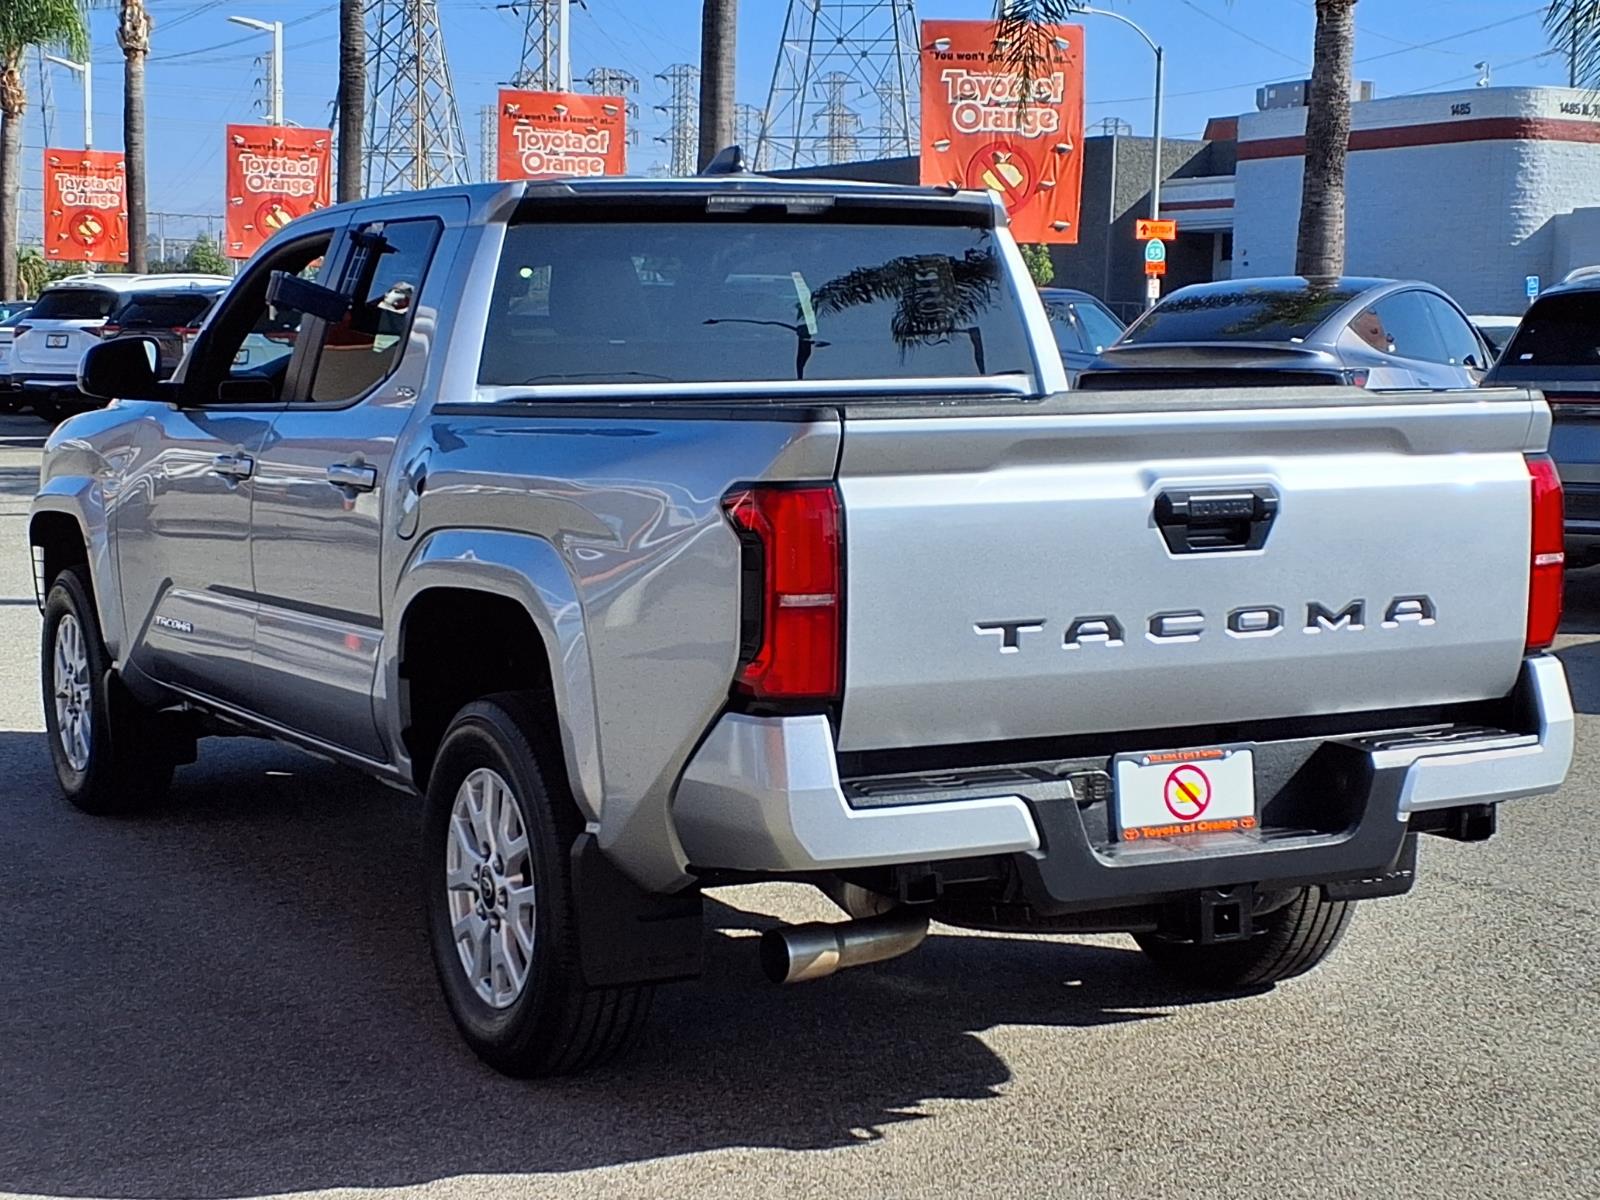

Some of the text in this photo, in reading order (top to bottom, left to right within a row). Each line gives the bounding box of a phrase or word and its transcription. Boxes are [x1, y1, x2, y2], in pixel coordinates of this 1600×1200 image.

[956, 52, 985, 61] won't
[942, 71, 1032, 102] Toyot
[1451, 102, 1471, 116] 1485
[1559, 102, 1581, 114] 1485
[515, 128, 608, 152] Toyota of
[239, 155, 317, 175] Toyota of
[523, 151, 603, 175] Orange
[56, 174, 105, 191] Toyota
[246, 174, 313, 195] Orange
[155, 615, 192, 632] TACOMA
[974, 594, 1437, 654] TACOMA
[1141, 823, 1181, 839] Toyota
[1182, 820, 1196, 833] of
